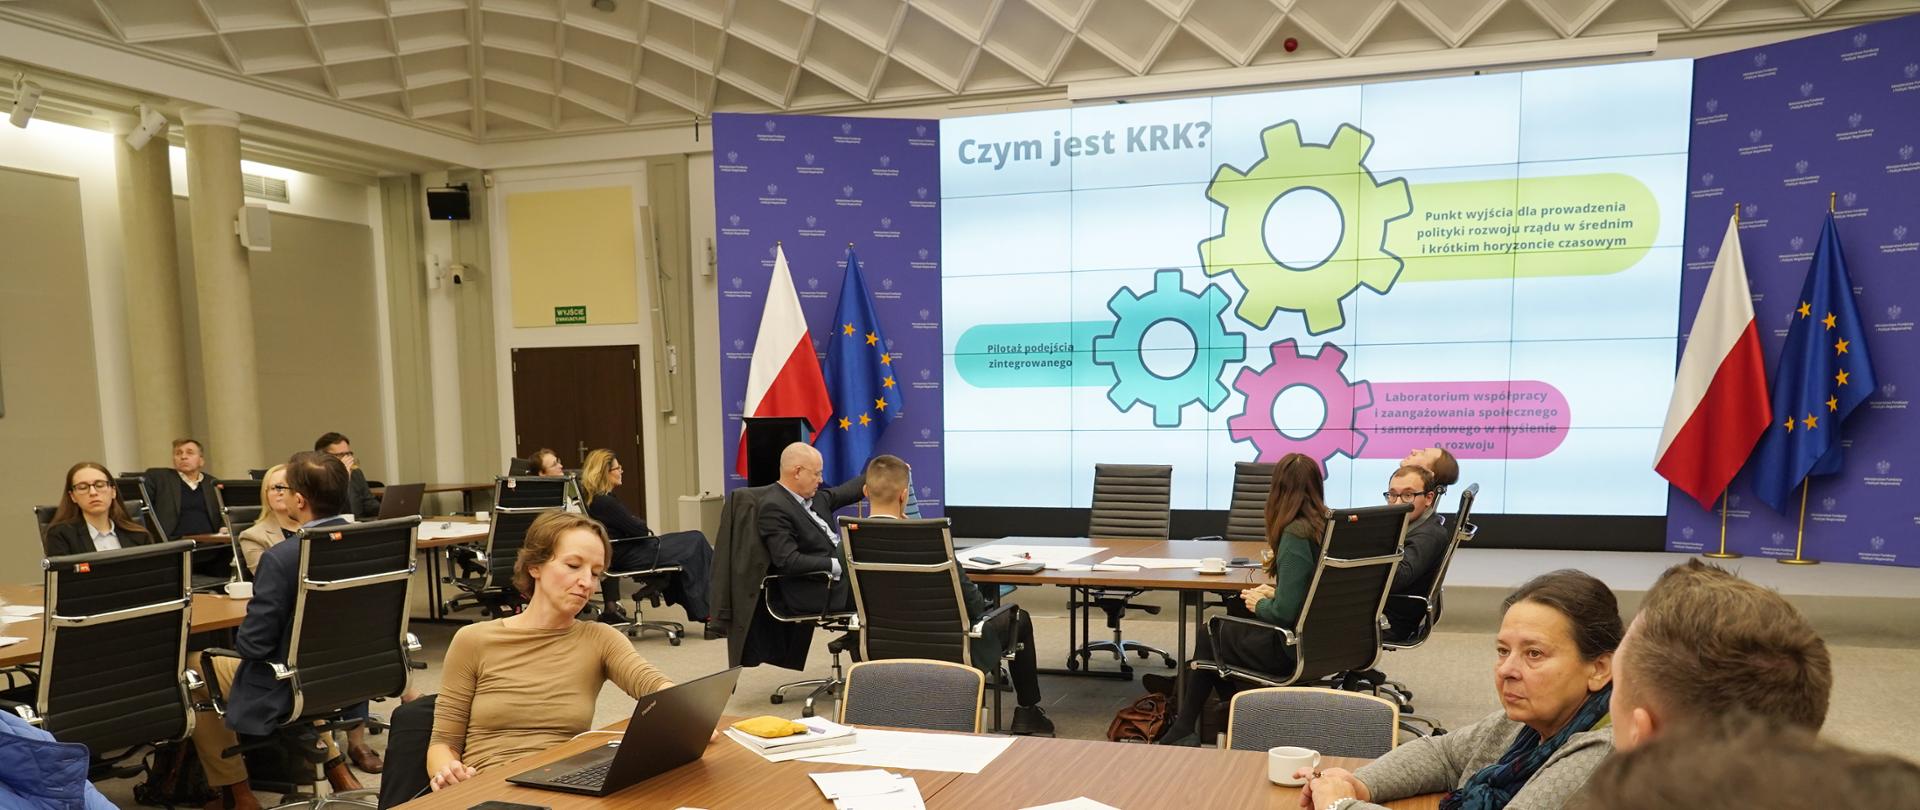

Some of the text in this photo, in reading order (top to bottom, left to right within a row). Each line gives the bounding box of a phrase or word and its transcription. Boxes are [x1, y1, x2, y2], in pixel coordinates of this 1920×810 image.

[958, 121, 1212, 170] Czym jest KRK?
[1425, 201, 1626, 222] Punkt wyjścia dla prowadzenia
[1417, 218, 1634, 240] polityki rozwoju rządu w średnim
[1422, 236, 1627, 254] i krótkim horyzoncie czasowym
[987, 342, 1074, 355] Pilotaż podejścia
[988, 359, 1072, 370] zintegrowanego
[1385, 390, 1548, 404] Laboratorium współpracy
[1374, 406, 1558, 420] i zaangażowania społecznego
[1374, 423, 1557, 436] i samorządowego w myślenie
[1445, 439, 1494, 452] rozwoju
